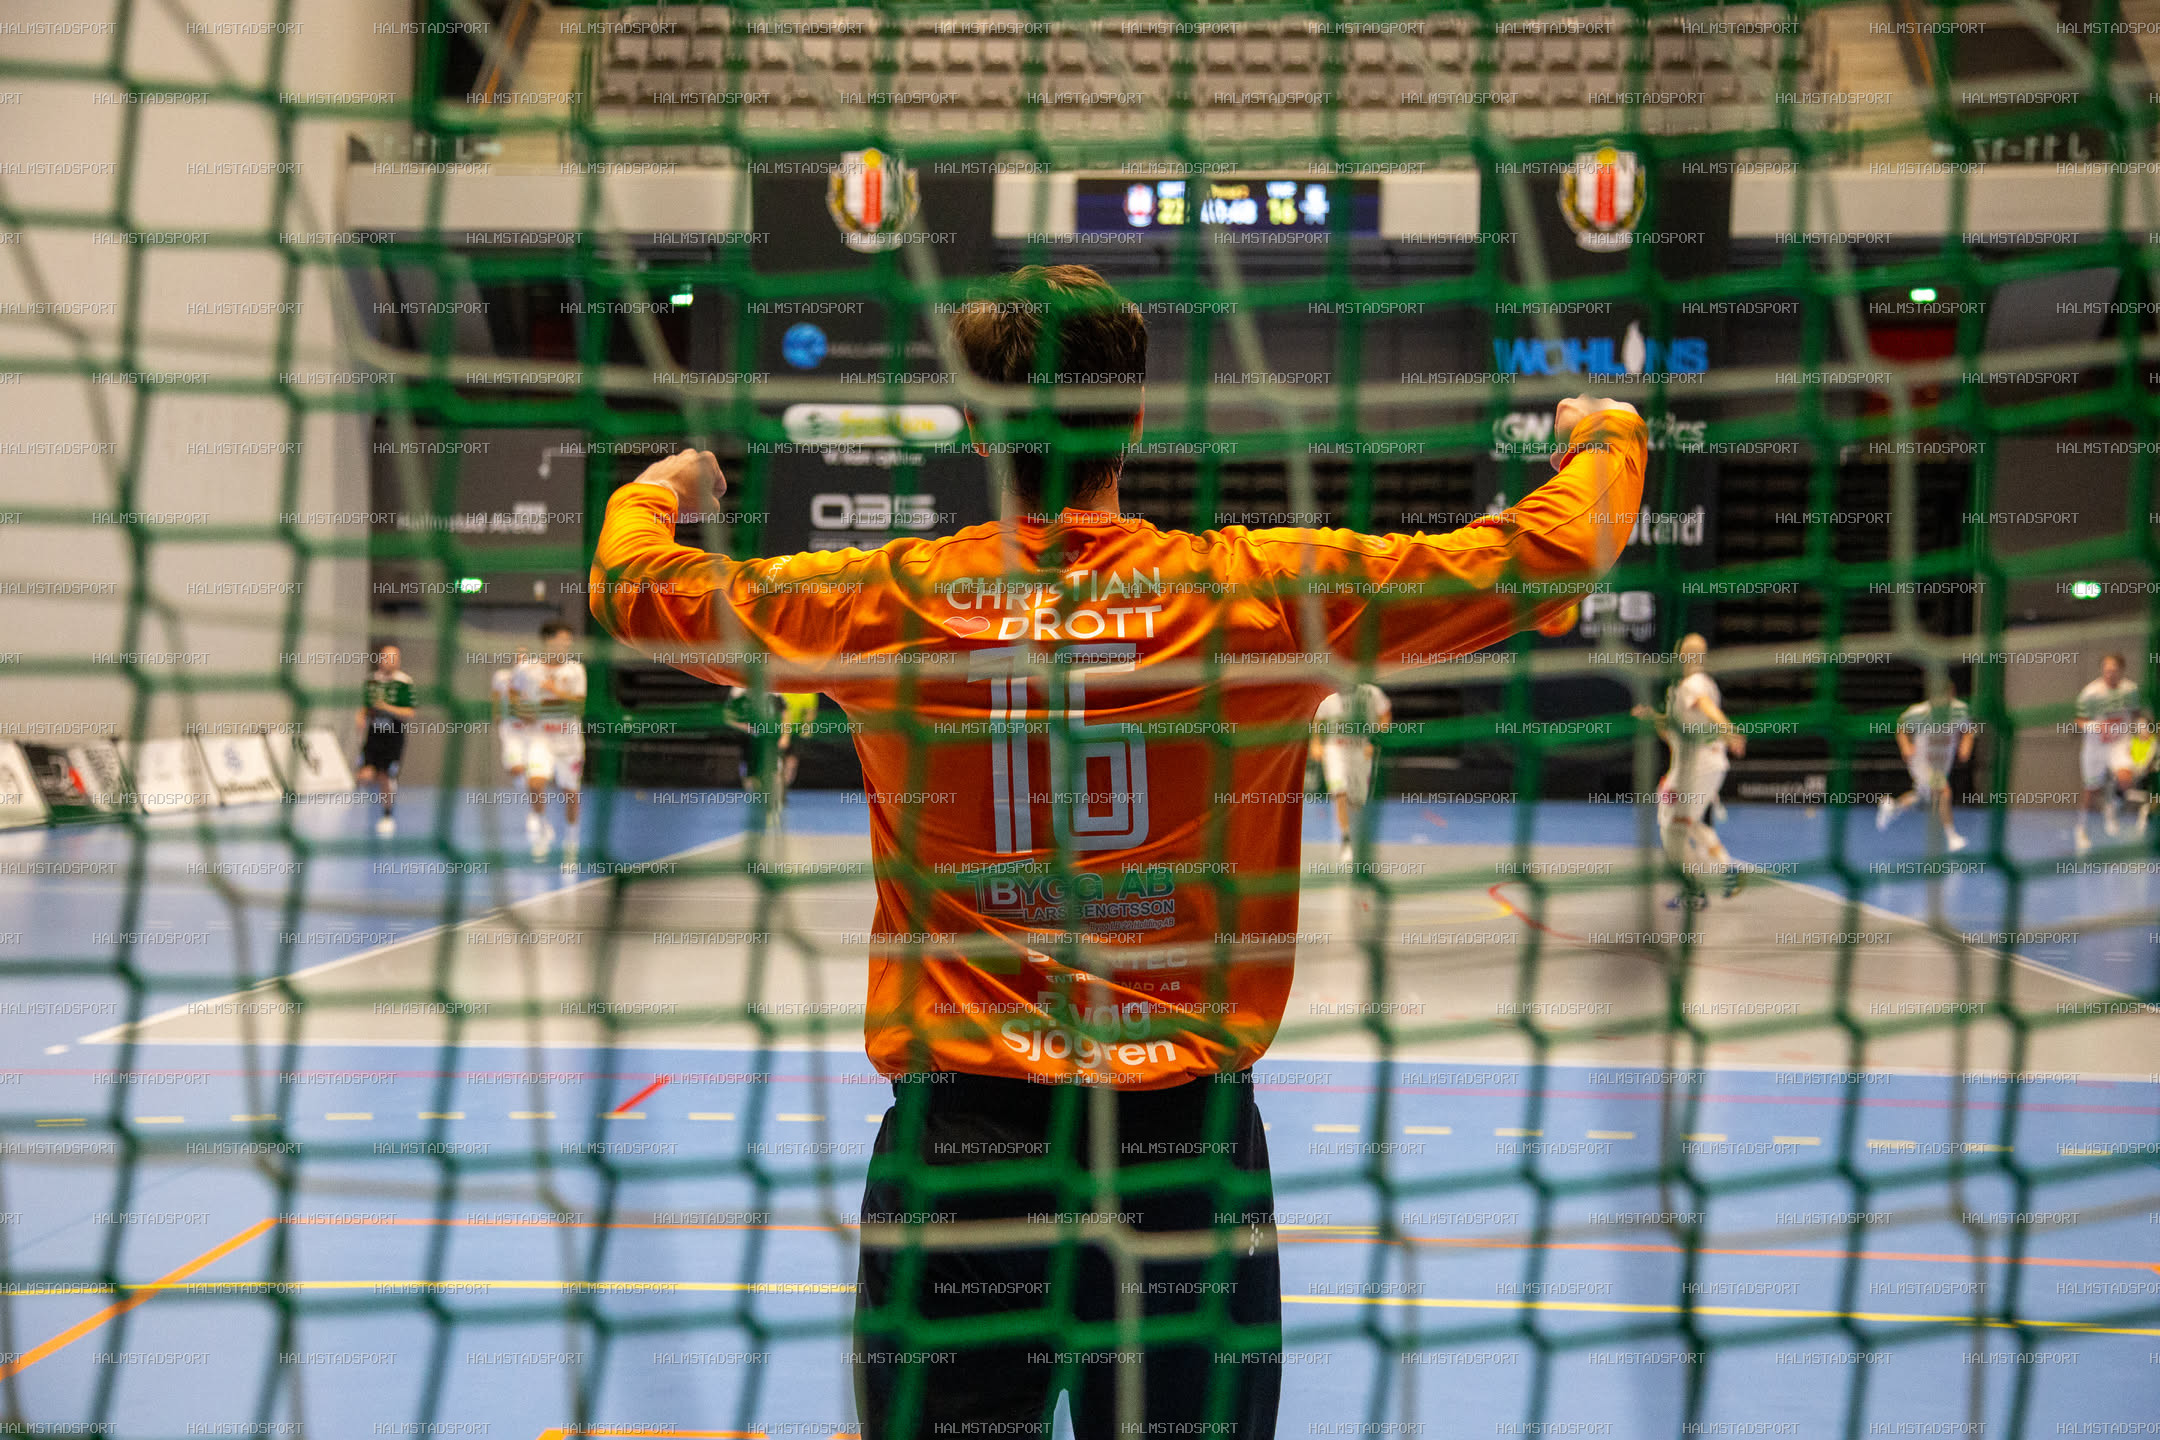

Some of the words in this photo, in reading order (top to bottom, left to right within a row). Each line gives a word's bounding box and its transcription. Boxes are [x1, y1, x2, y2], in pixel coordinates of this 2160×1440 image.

[946, 566, 1162, 611] CHRISTIAN
[998, 605, 1162, 640] DROTT
[968, 643, 1150, 854] 16
[1117, 867, 1176, 900] AB
[1023, 906, 1068, 923] LARS
[1160, 980, 1180, 992] AB
[1000, 1017, 1177, 1069] Sjögren
